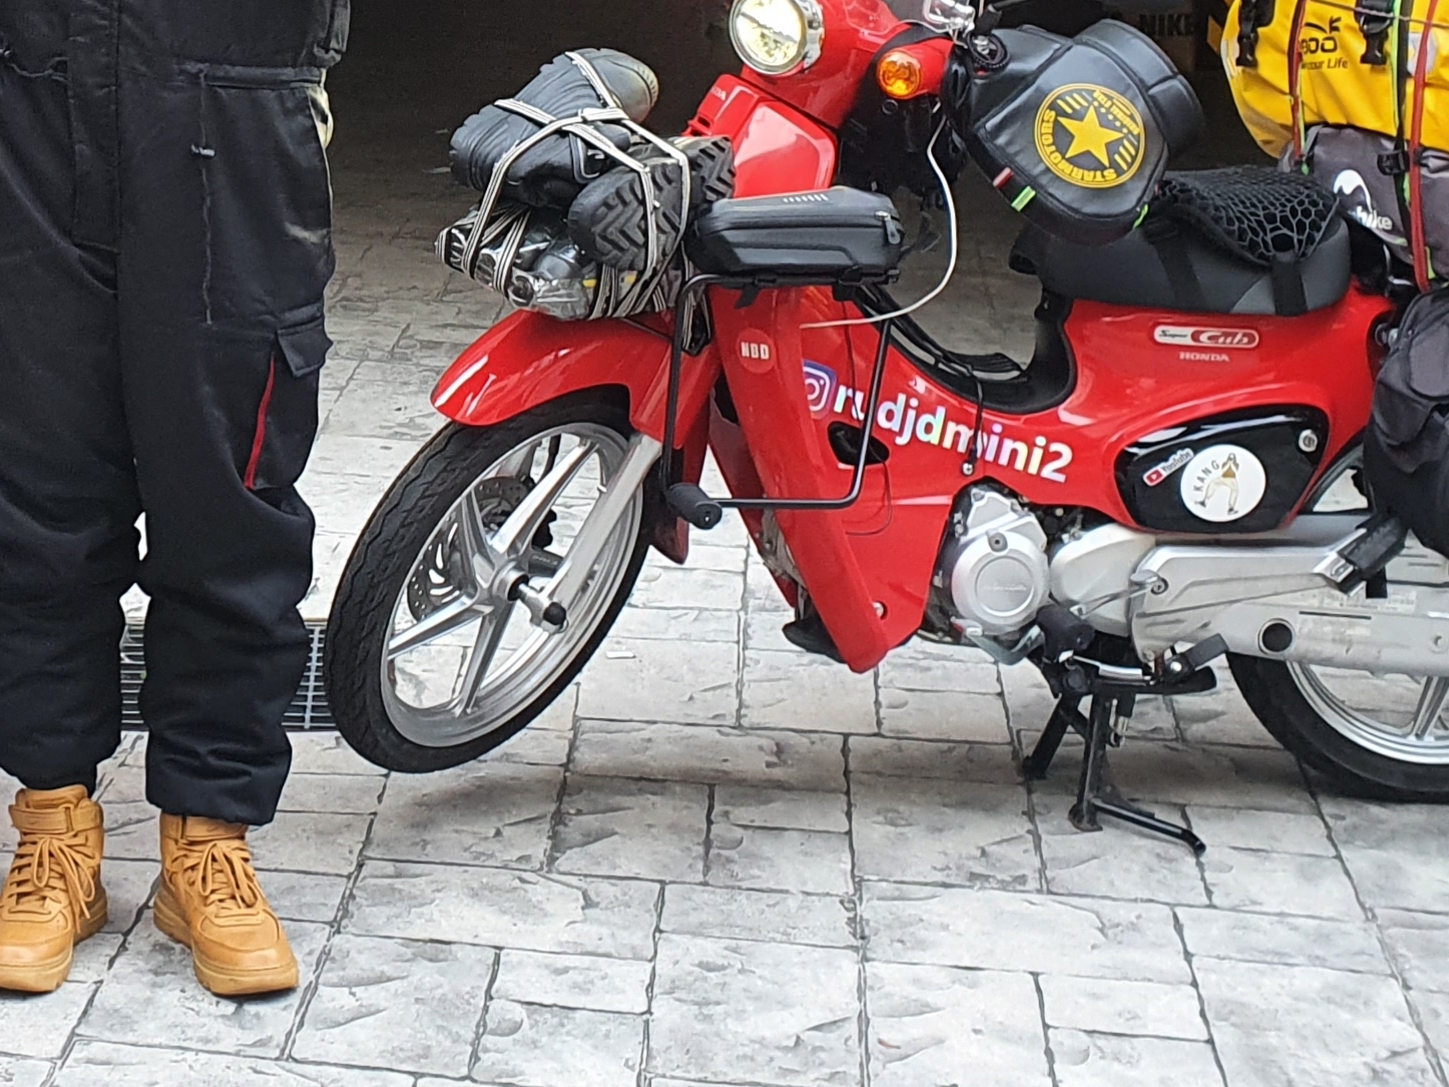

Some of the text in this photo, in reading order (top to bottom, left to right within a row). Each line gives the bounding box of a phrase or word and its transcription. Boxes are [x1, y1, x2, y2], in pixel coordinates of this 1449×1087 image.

[1041, 109, 1117, 182] STARMOTORS
[1198, 331, 1250, 345] Cub
[1179, 351, 1230, 362] HONDA
[1193, 459, 1220, 492] KANG
